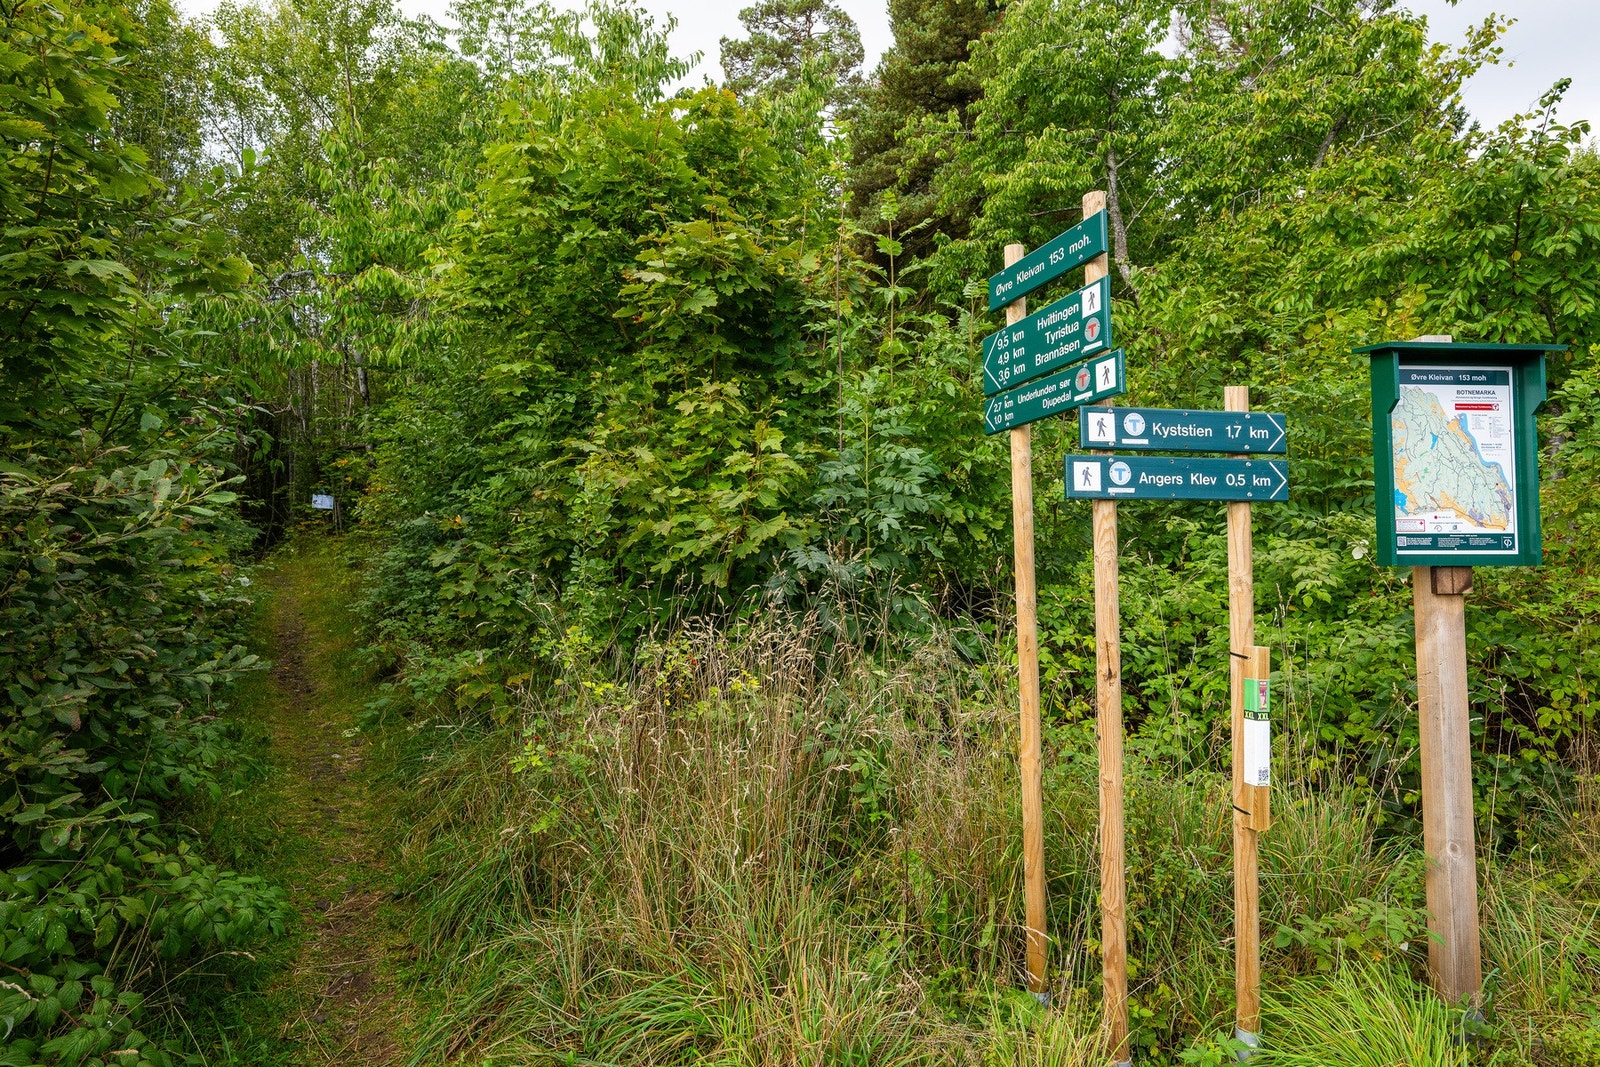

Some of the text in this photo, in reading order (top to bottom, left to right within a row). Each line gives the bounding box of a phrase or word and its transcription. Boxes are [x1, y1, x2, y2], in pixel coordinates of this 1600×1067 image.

[995, 233, 1092, 297] Øvre Kleivan 153 moh.
[997, 303, 1079, 350] 9,5 km Hvittingen
[997, 321, 1079, 366] 4,9 km Tyristua
[998, 339, 1080, 382] 3,6 km Brannåsen
[1004, 399, 1014, 409] km
[1017, 384, 1057, 404] Underlunden
[1059, 379, 1071, 390] sør
[1004, 412, 1014, 421] km
[1042, 390, 1072, 409] Djupedal
[1152, 422, 1212, 438] Kyststien
[1226, 425, 1242, 439] 1,7
[1250, 426, 1269, 439] km
[1139, 472, 1183, 486] Angers
[1190, 473, 1217, 485] Klev
[1226, 474, 1246, 487] 0,5
[1253, 475, 1271, 487] km
[1258, 712, 1269, 721] XXL
